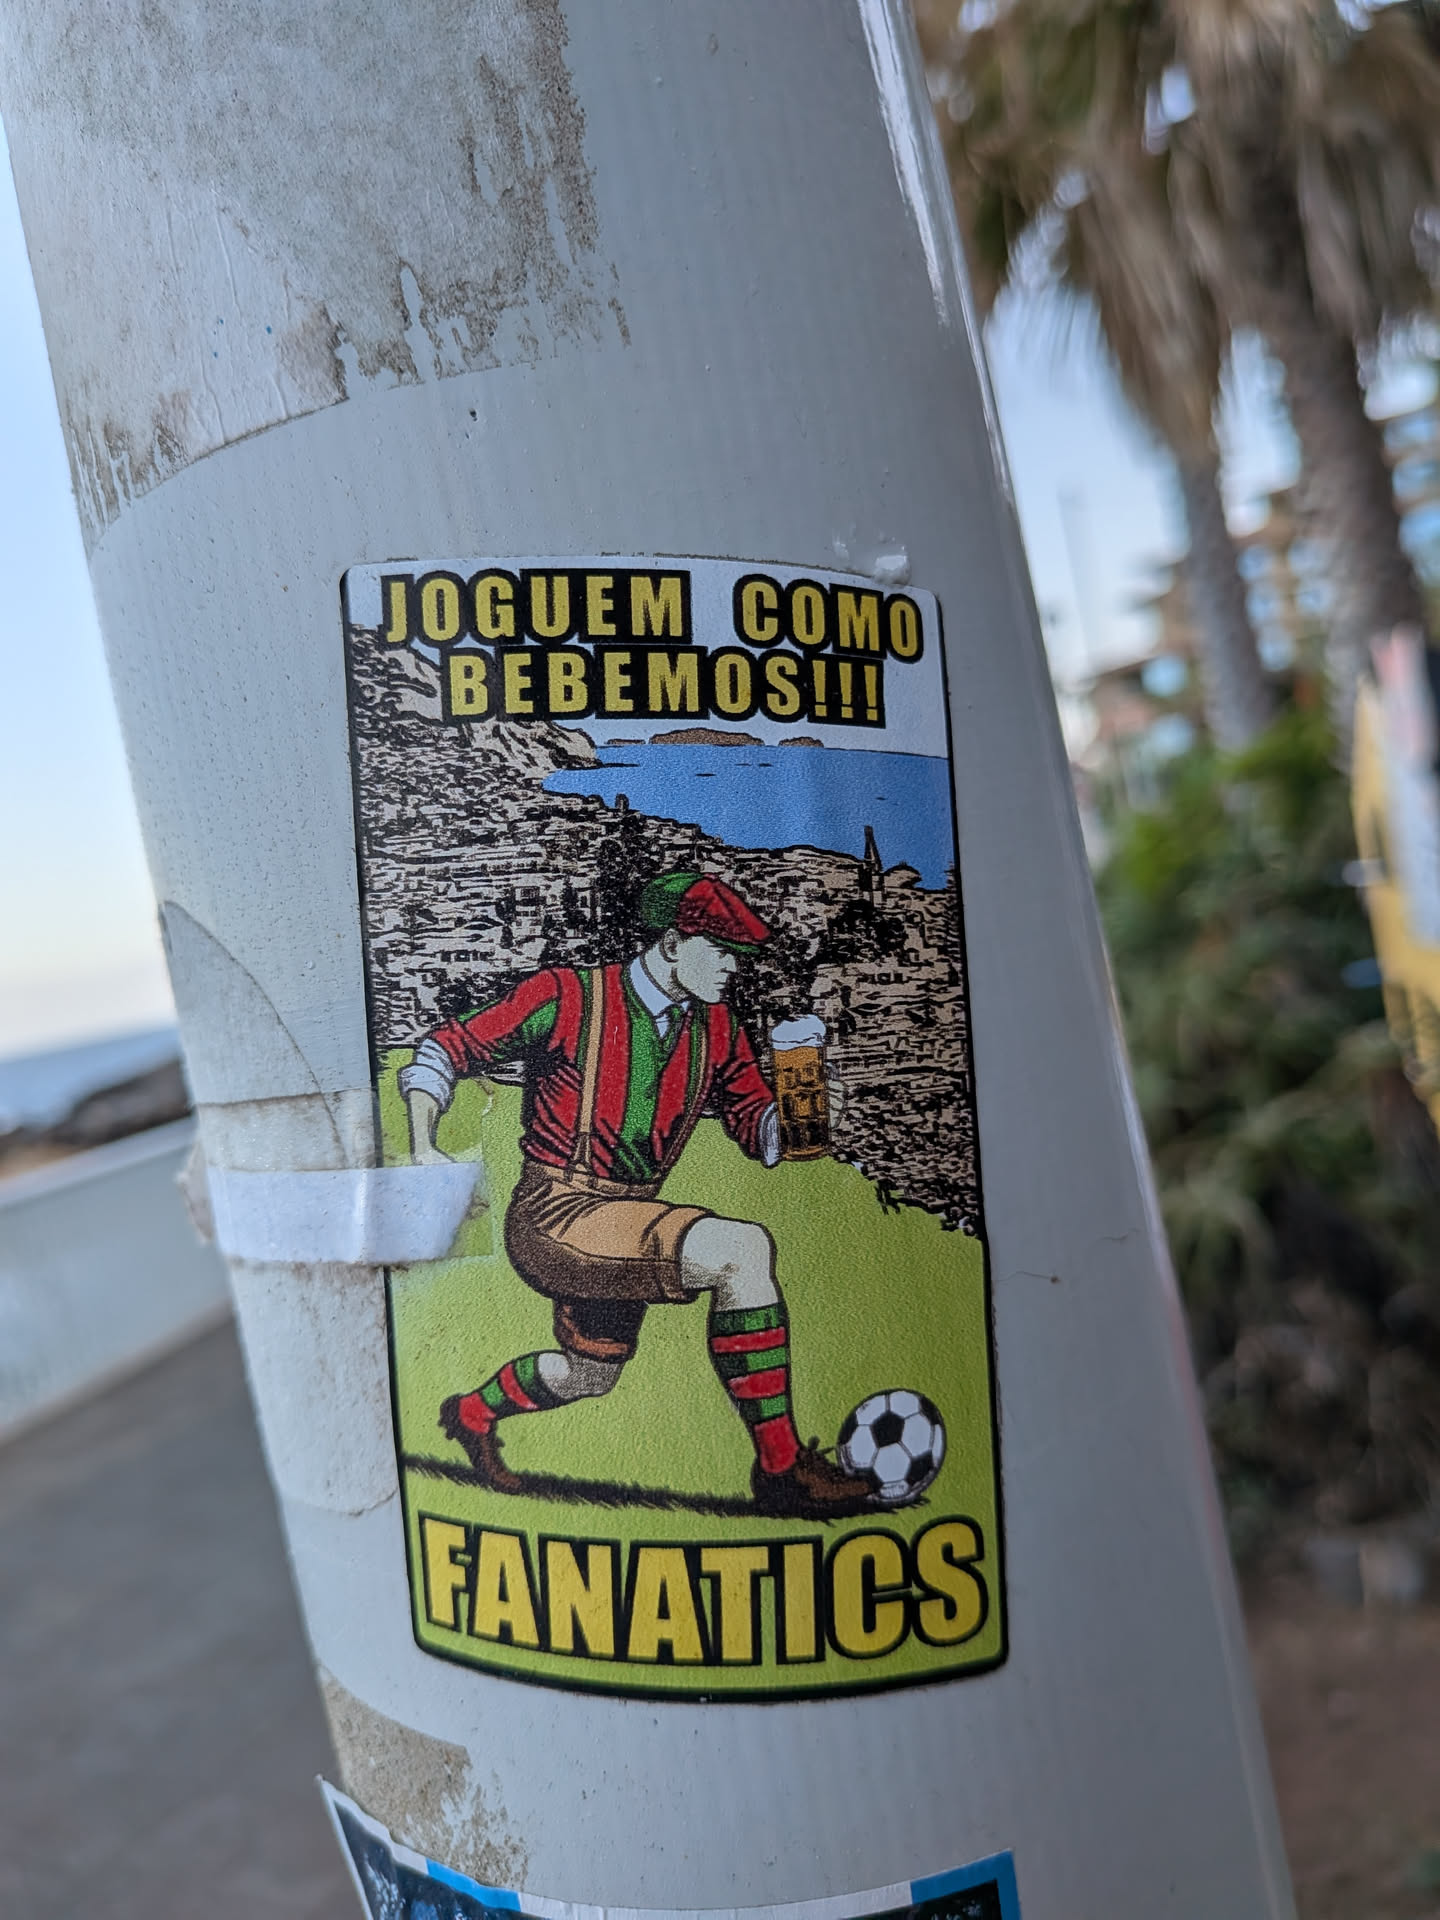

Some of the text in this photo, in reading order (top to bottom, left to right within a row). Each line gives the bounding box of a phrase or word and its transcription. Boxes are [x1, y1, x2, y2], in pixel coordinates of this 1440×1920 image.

[383, 570, 922, 660] JOGUEM COMO
[447, 648, 883, 725] BEBEMOS!!!
[420, 1516, 988, 1666] FANATICS
